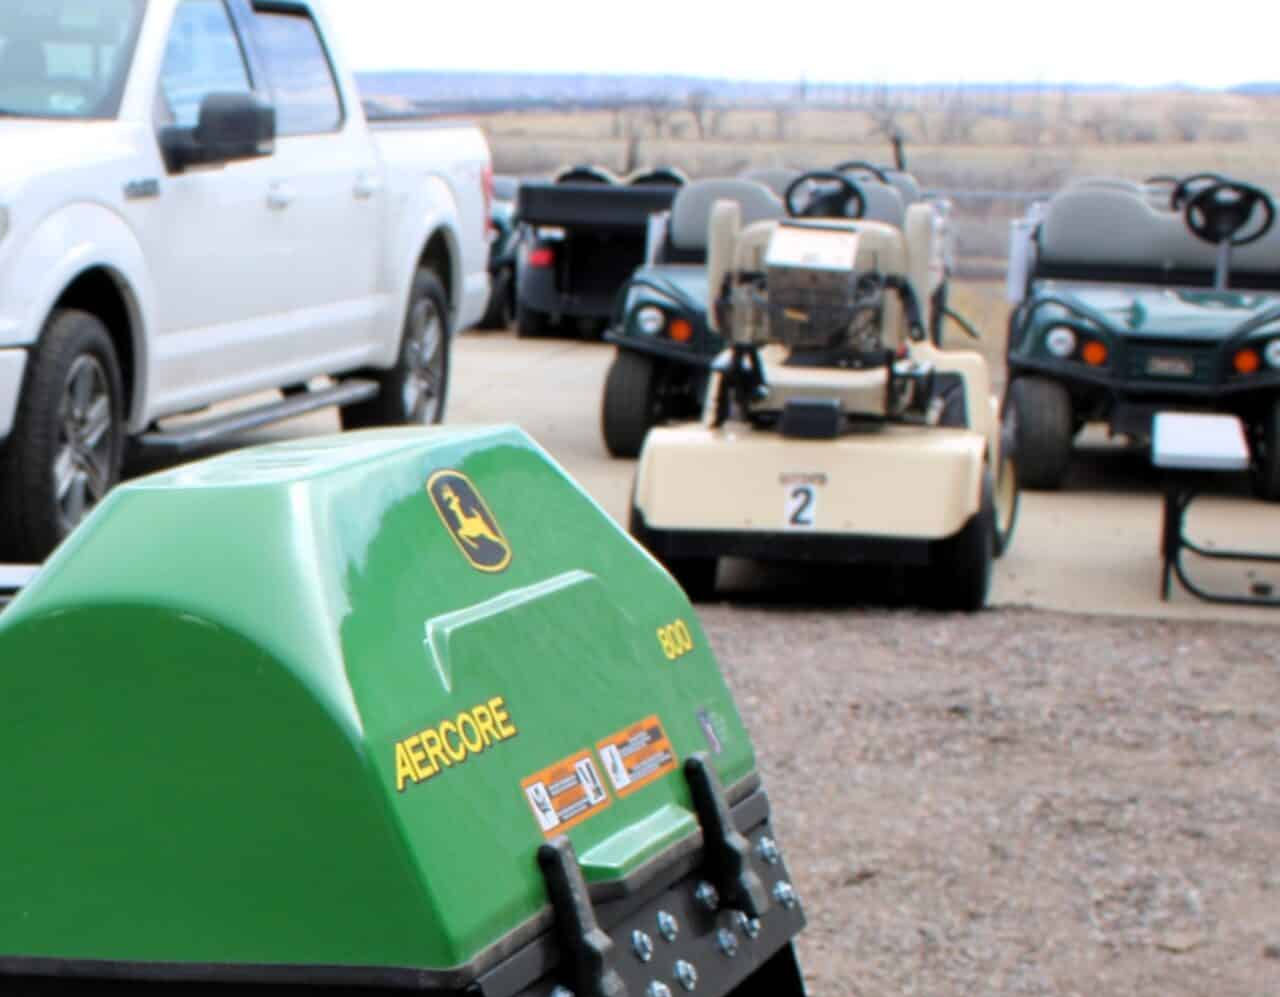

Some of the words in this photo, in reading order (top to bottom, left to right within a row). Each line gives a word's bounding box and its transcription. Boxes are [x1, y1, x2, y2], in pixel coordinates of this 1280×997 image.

[789, 486, 813, 525] 2
[656, 617, 694, 660] 800
[394, 695, 518, 792] AERCORE
